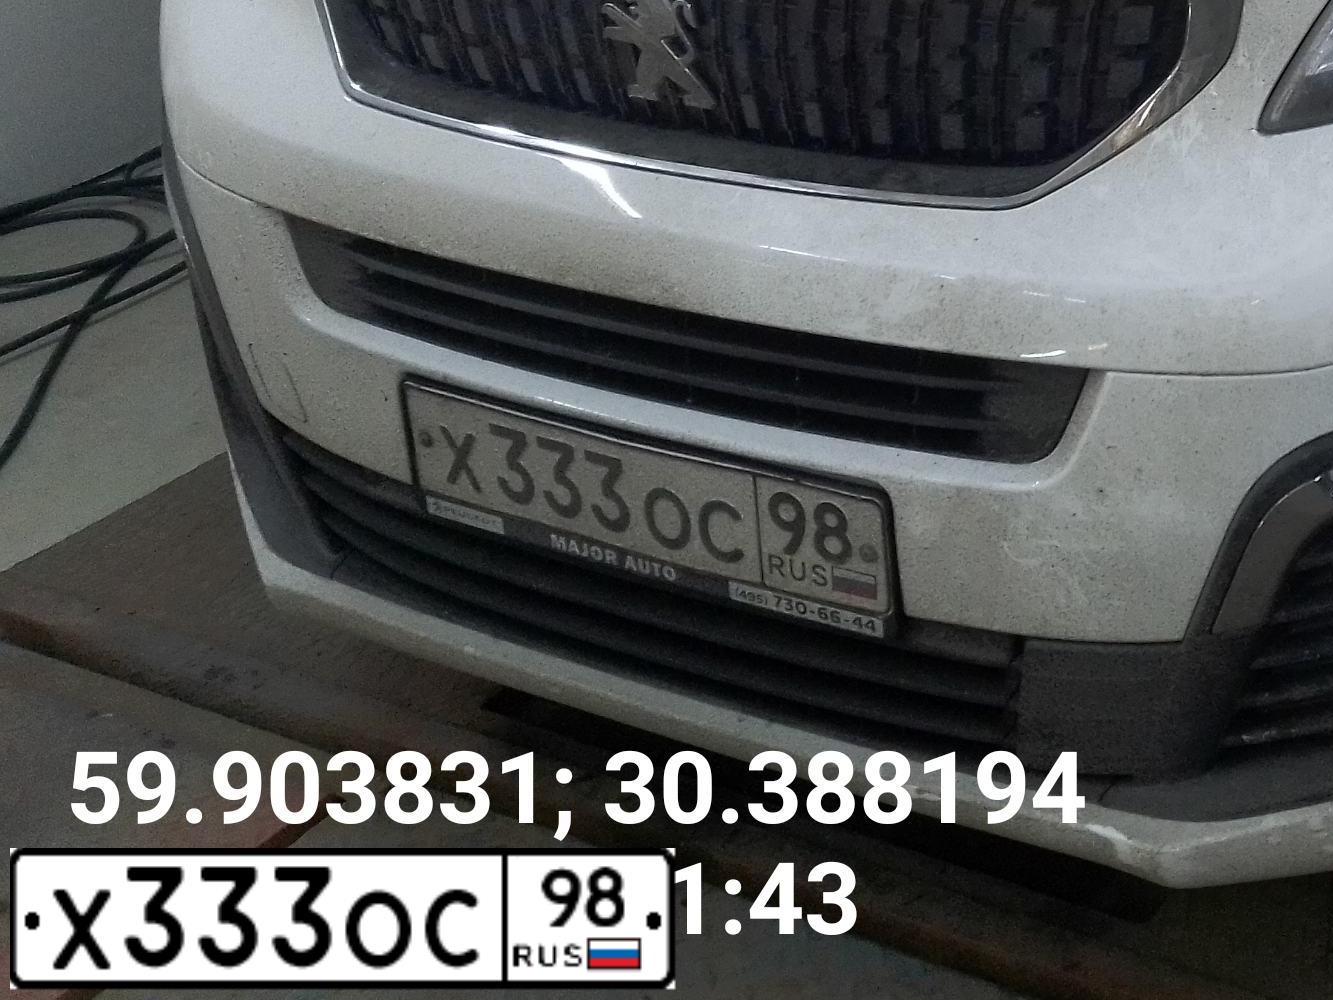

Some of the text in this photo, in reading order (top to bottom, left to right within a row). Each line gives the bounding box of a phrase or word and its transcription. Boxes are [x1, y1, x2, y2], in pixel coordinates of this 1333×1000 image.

[768, 491, 852, 565] 98
[550, 533, 678, 582] MAJOR AUTO
[768, 553, 828, 587] RUS
[772, 594, 876, 633] 730-66-44
